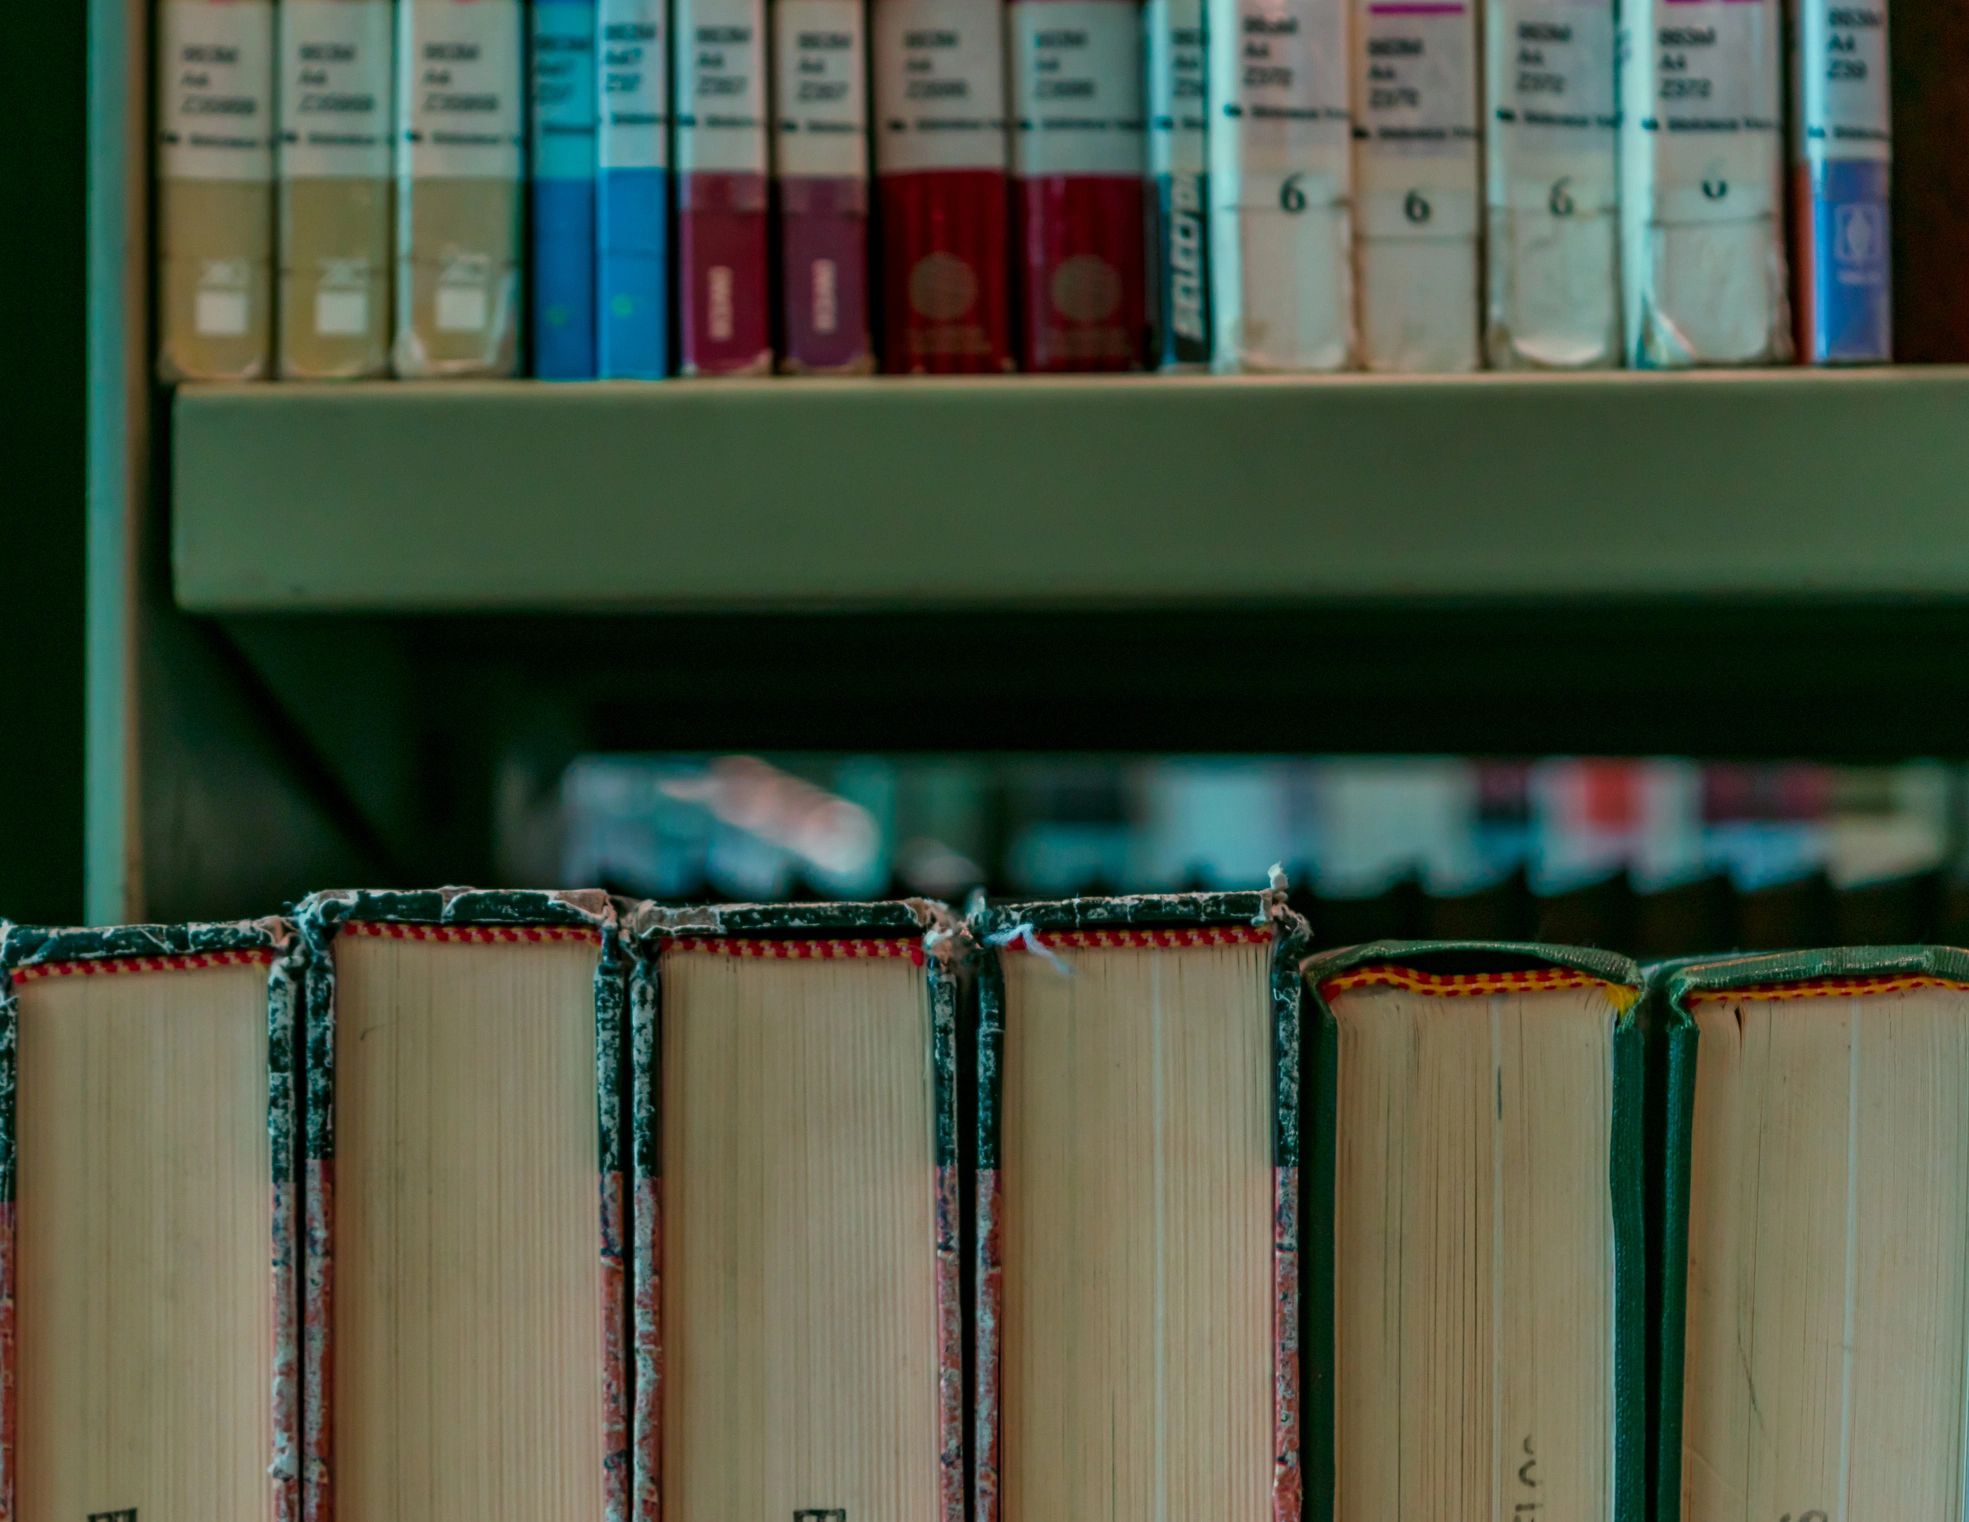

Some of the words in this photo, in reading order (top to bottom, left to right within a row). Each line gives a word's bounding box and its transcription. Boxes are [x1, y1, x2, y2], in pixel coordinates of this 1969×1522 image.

[1279, 173, 1307, 213] 6
[1404, 189, 1431, 223] 6
[1550, 176, 1575, 218] 6
